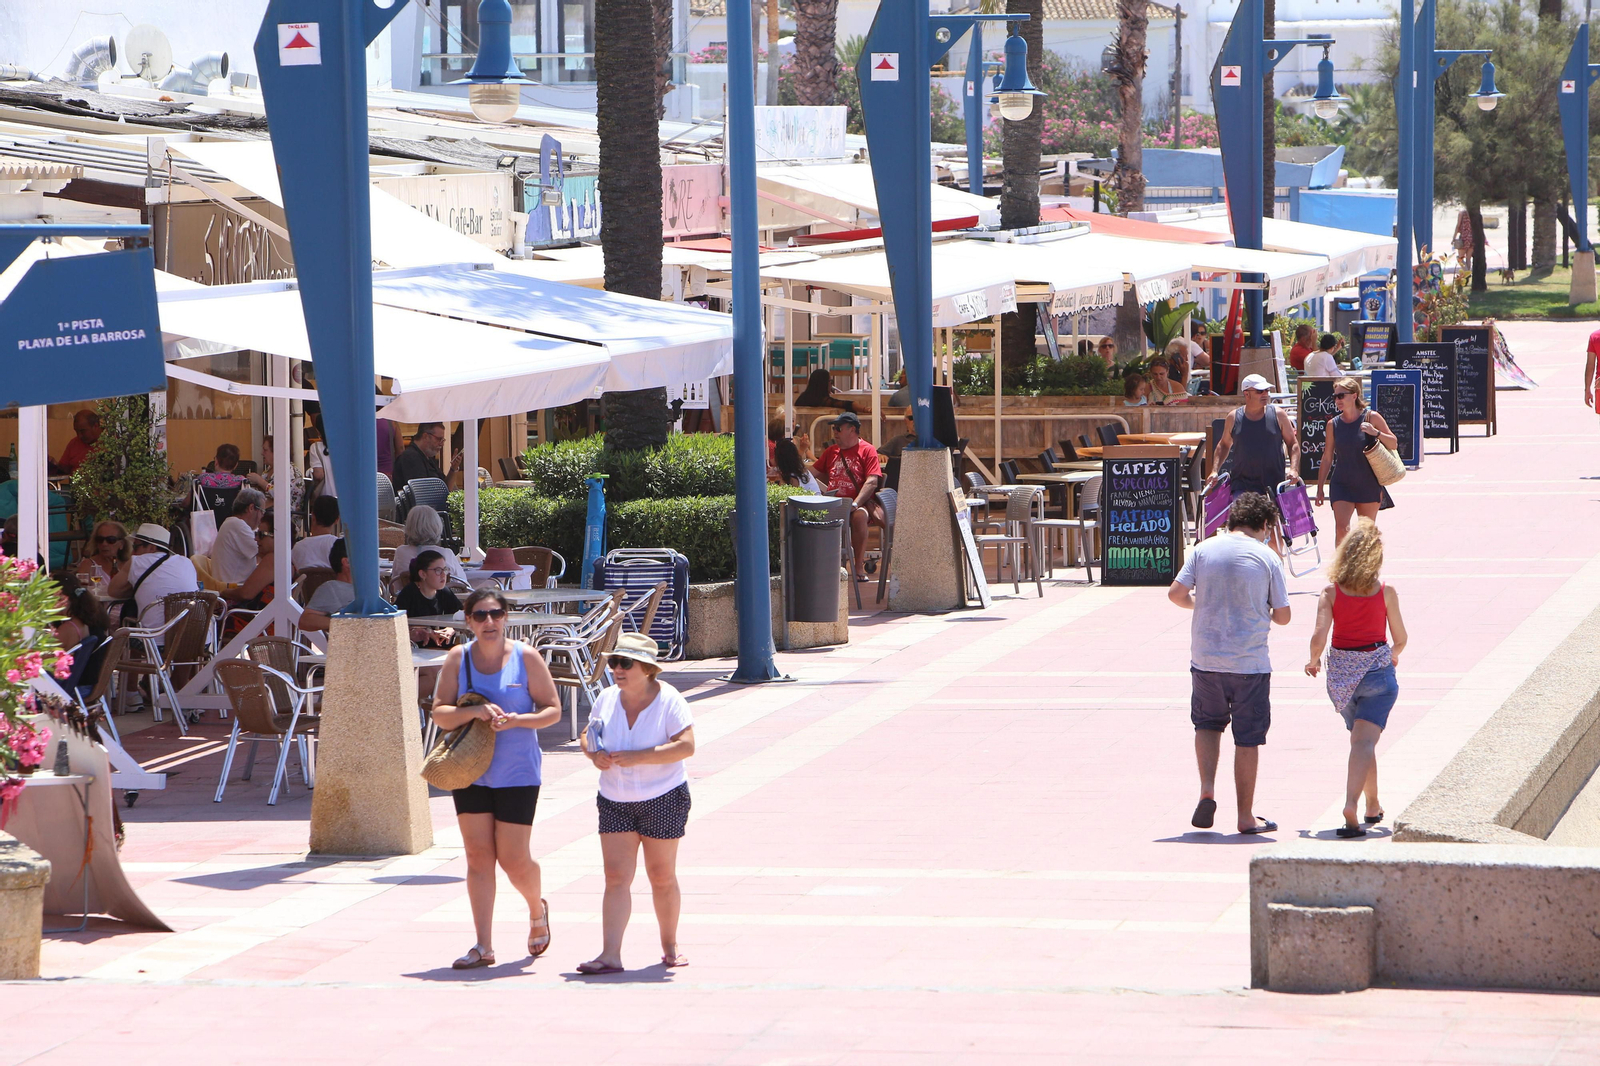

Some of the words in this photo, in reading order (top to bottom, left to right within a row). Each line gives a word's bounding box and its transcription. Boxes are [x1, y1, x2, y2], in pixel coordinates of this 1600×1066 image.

[57, 322, 70, 332] 1ª
[71, 318, 105, 331] PISTA
[17, 337, 54, 350] PLAYA
[56, 335, 73, 347] DE
[74, 334, 90, 345] LA
[91, 329, 147, 343] BARROSA
[1112, 477, 1169, 490] ESPECIALES
